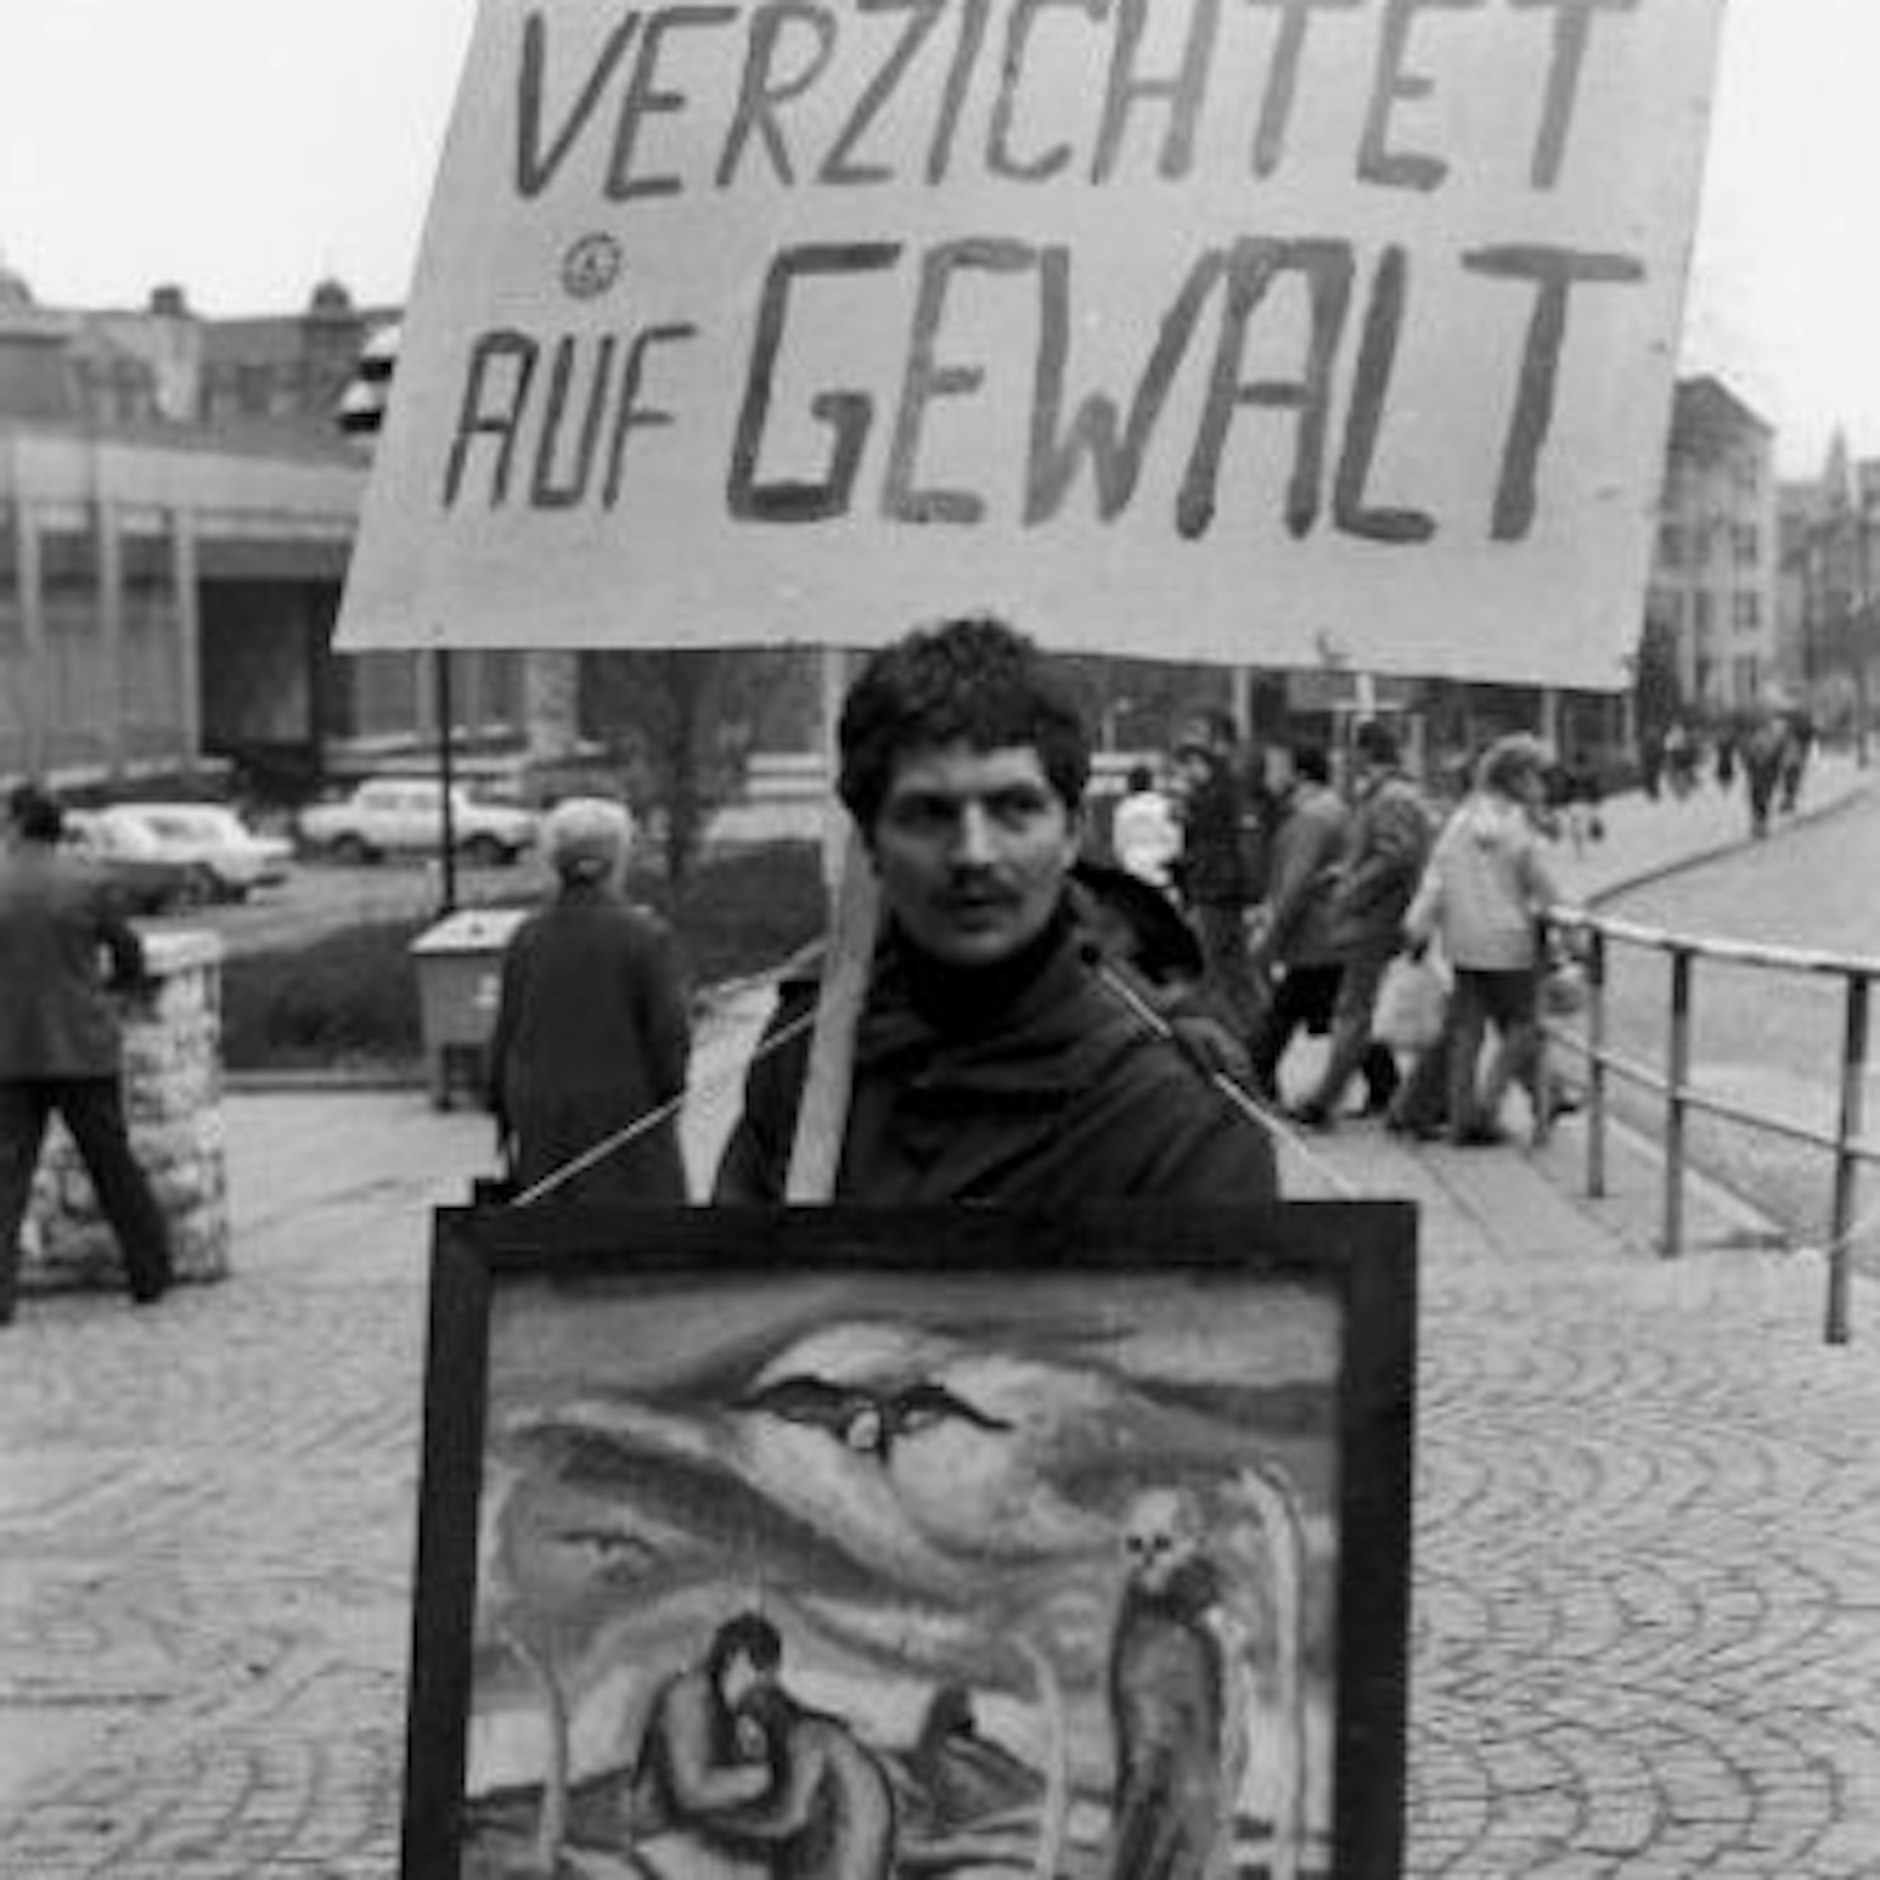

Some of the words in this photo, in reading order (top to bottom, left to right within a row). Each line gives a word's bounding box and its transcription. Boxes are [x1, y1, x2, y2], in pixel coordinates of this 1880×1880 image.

[515, 0, 1639, 200] VERZICHTET
[441, 322, 698, 513] AUF
[725, 236, 1645, 545] GEWALT
